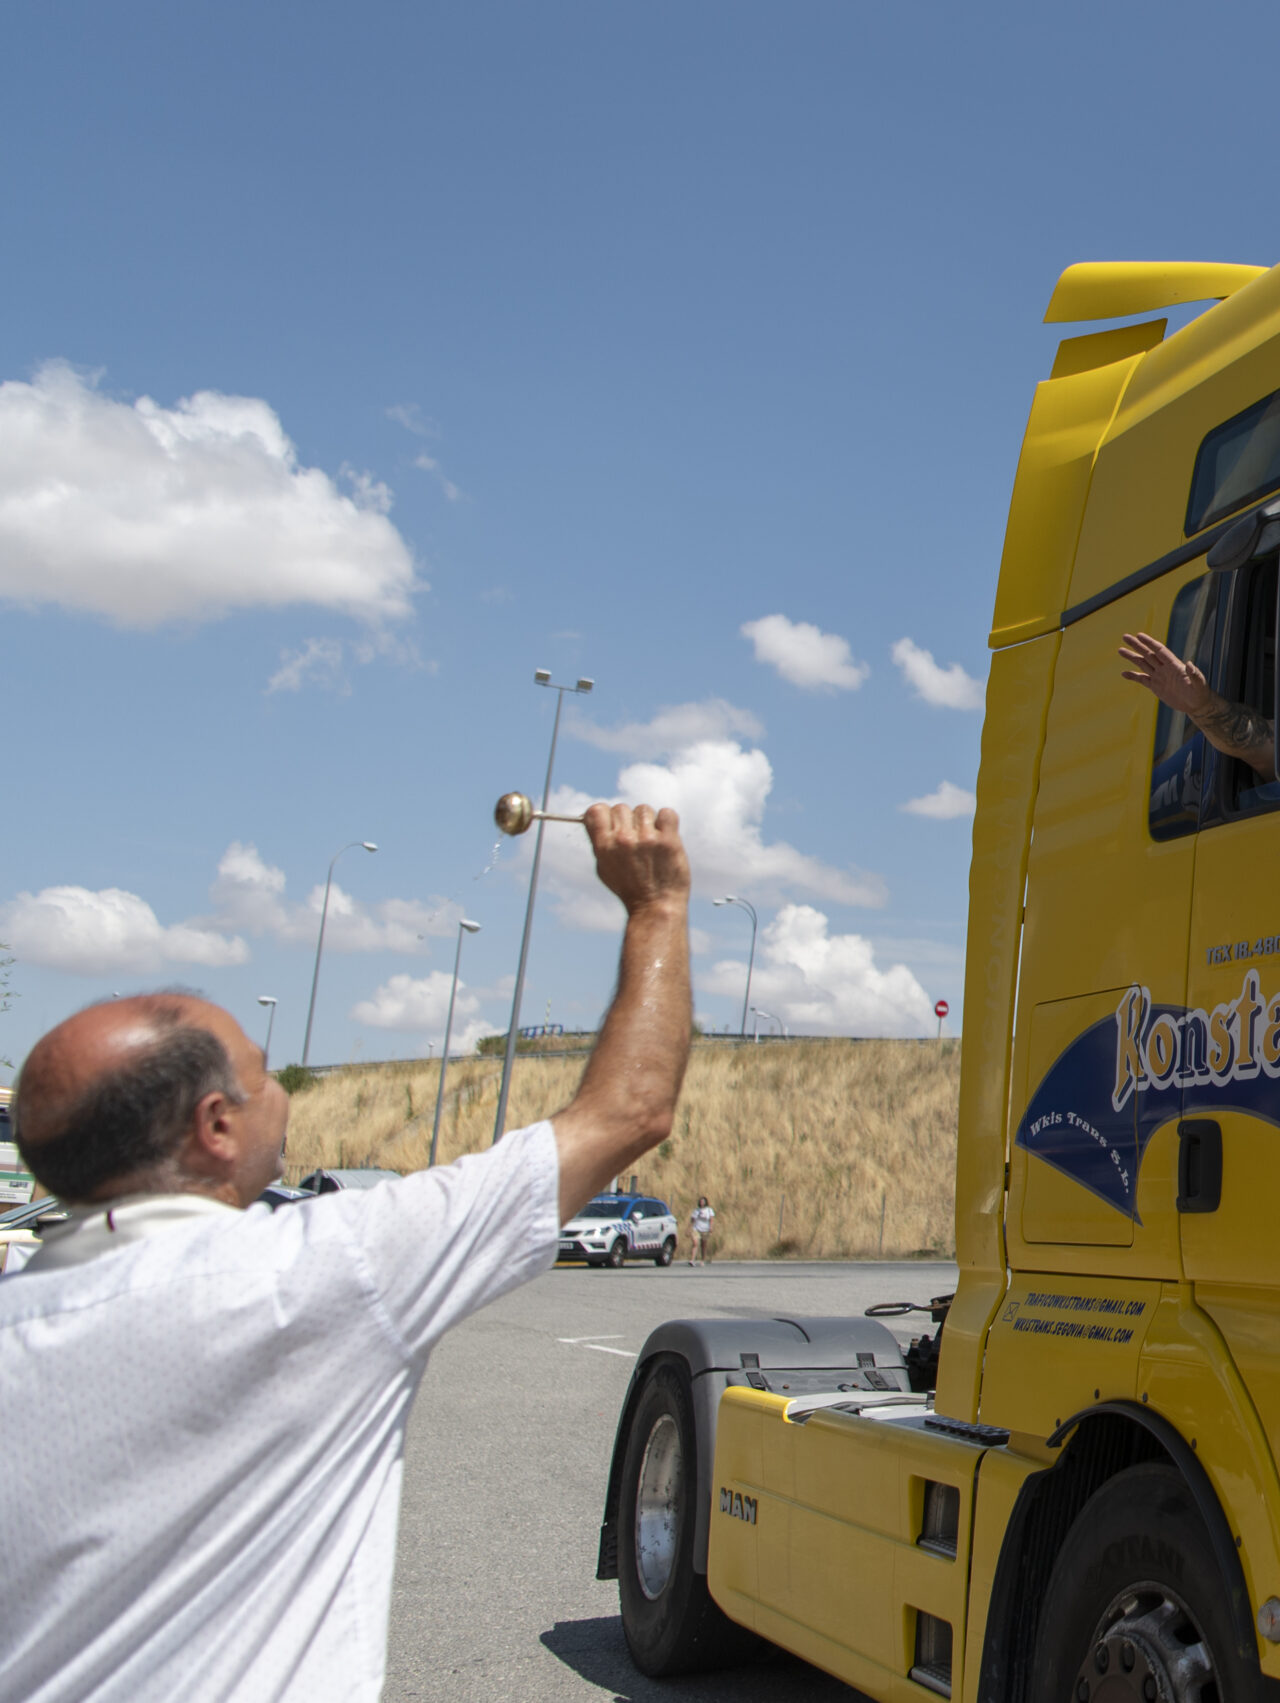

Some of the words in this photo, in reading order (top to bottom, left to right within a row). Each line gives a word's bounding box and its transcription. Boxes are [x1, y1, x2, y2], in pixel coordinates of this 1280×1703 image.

[1206, 944, 1232, 966] TGX
[1030, 1111, 1063, 1137] Wkis
[1067, 1112, 1109, 1148] Trans
[720, 1487, 757, 1525] MAN
